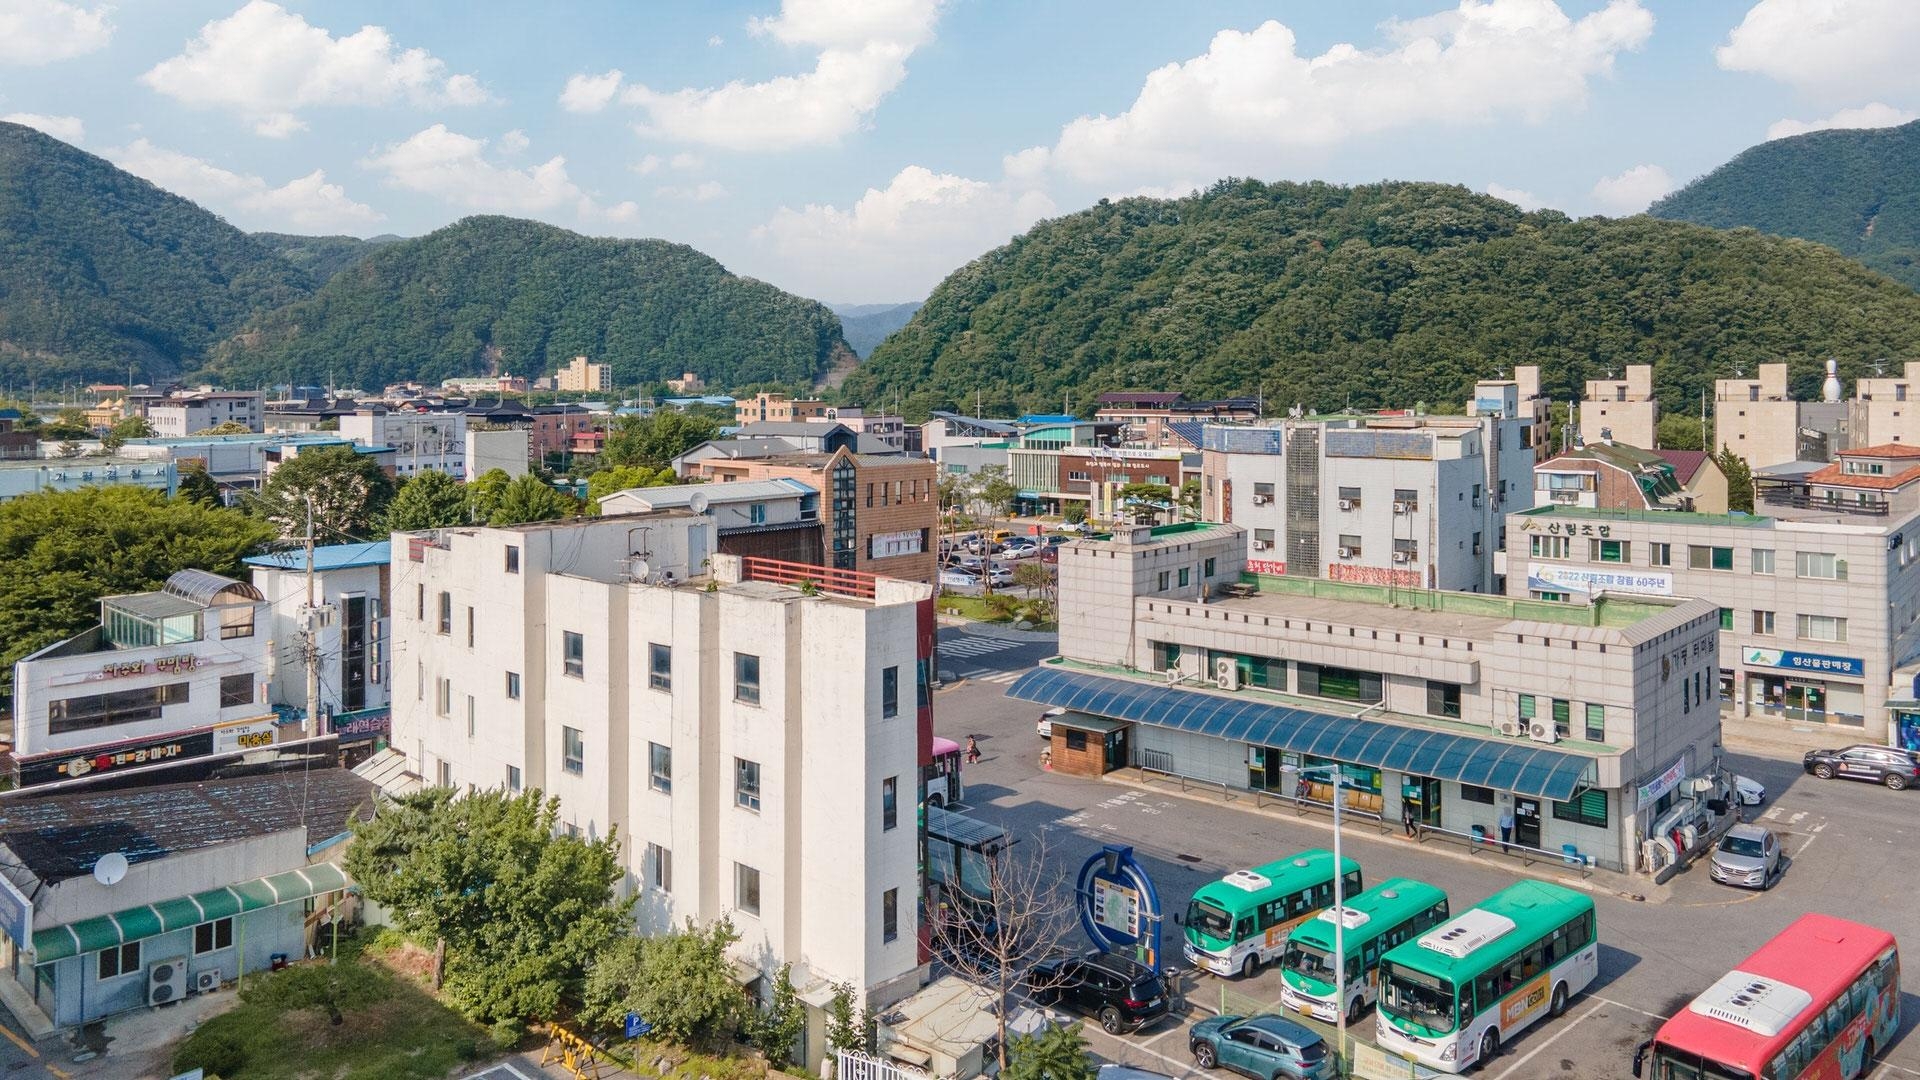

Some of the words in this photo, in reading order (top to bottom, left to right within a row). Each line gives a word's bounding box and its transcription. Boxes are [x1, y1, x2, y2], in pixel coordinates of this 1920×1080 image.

[1548, 522, 1611, 538] 산림조합
[1636, 577, 1665, 589] 60주년
[1690, 633, 1715, 658] 터미널
[1792, 656, 1852, 672] 임산물판매장
[238, 730, 274, 747] 미용실
[1506, 995, 1529, 1022] MBN
[633, 1016, 640, 1026] P
